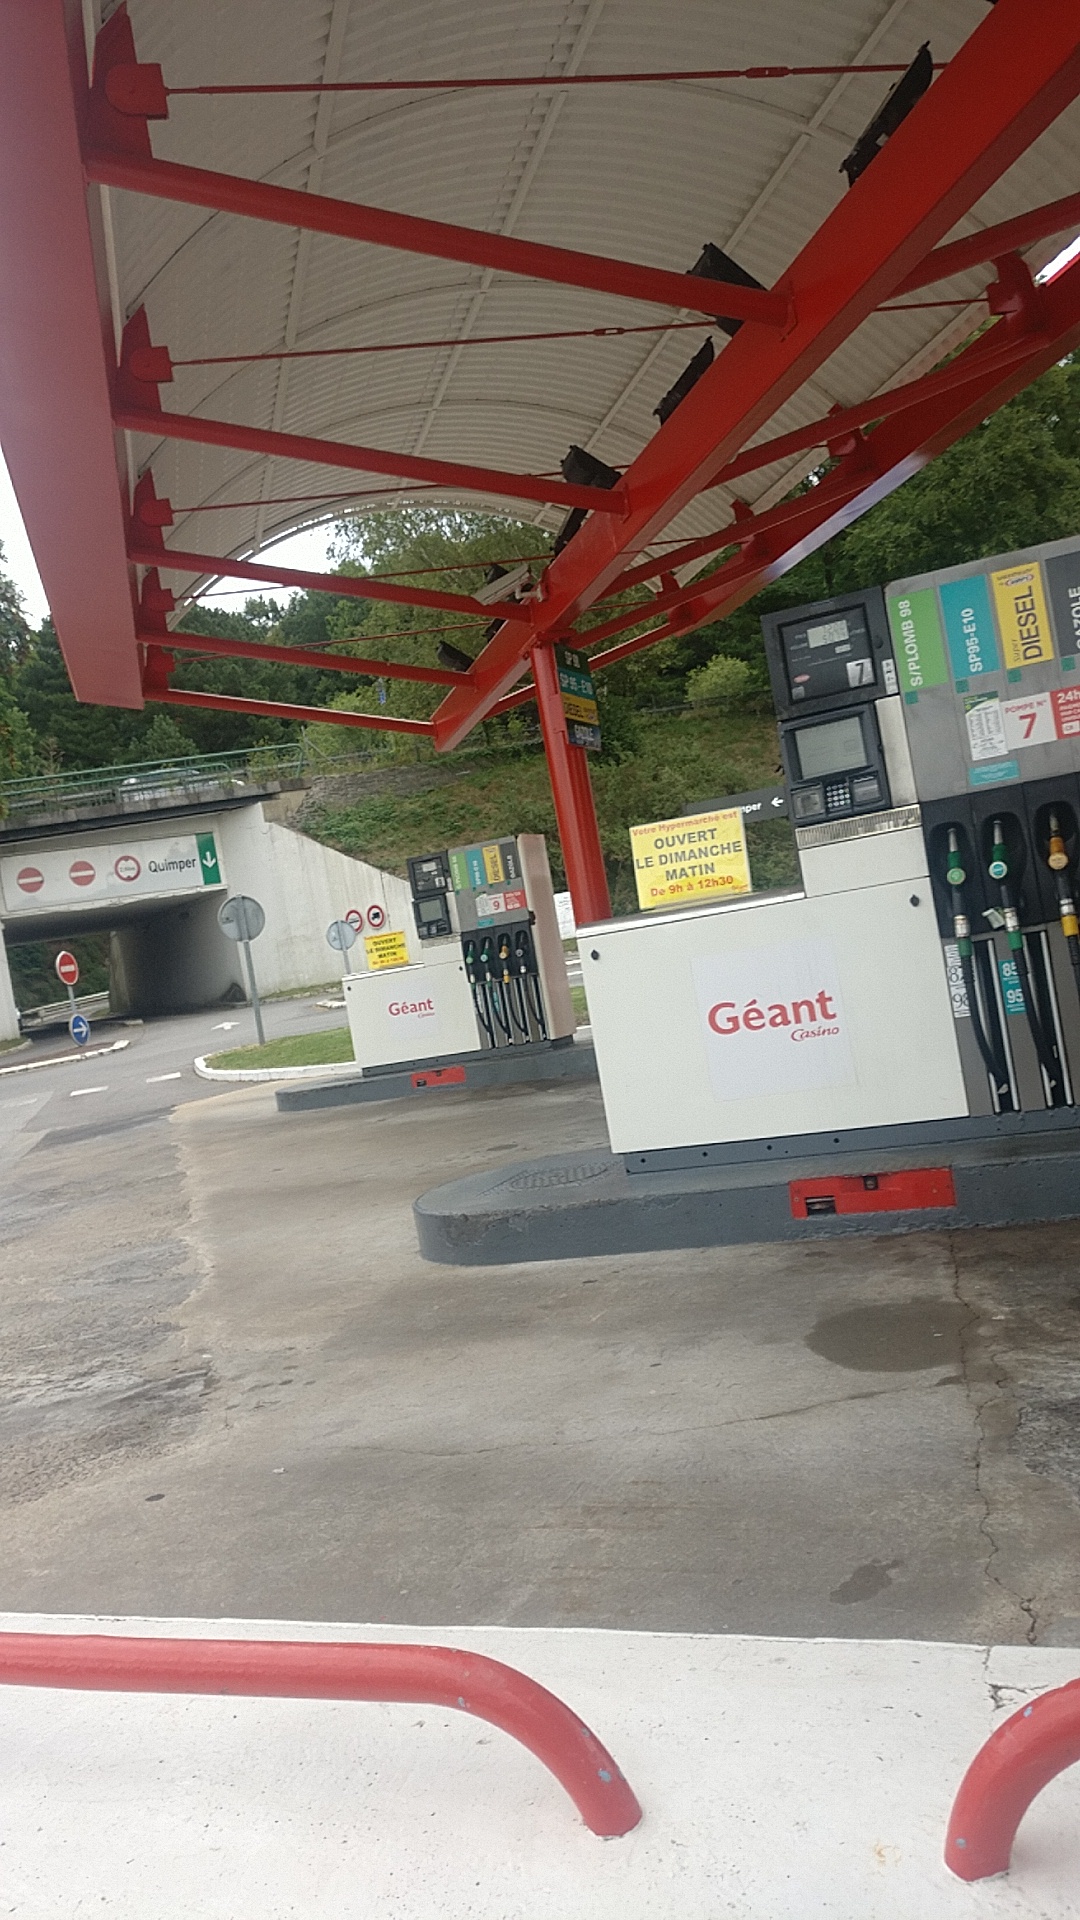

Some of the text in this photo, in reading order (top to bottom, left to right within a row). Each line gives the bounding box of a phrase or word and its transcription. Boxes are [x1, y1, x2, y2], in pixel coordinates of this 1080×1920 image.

[1014, 586, 1043, 660] DIESEL
[898, 600, 923, 687] S/PLOMB 98
[961, 608, 983, 672] SP95-E10
[855, 663, 864, 685] 7
[1019, 713, 1037, 739] 7
[654, 828, 718, 850] OUVERT
[148, 858, 197, 873] Quimper
[636, 841, 743, 870] LE DIMANCHE
[665, 862, 715, 881] MATIN
[650, 887, 666, 897] De
[669, 879, 683, 894] 9h
[698, 875, 734, 890] 12h30
[493, 900, 500, 911] 9
[388, 998, 435, 1016] Géant
[1007, 989, 1024, 1003] 95
[708, 990, 838, 1035] Géant
[791, 1026, 839, 1042] Casino
